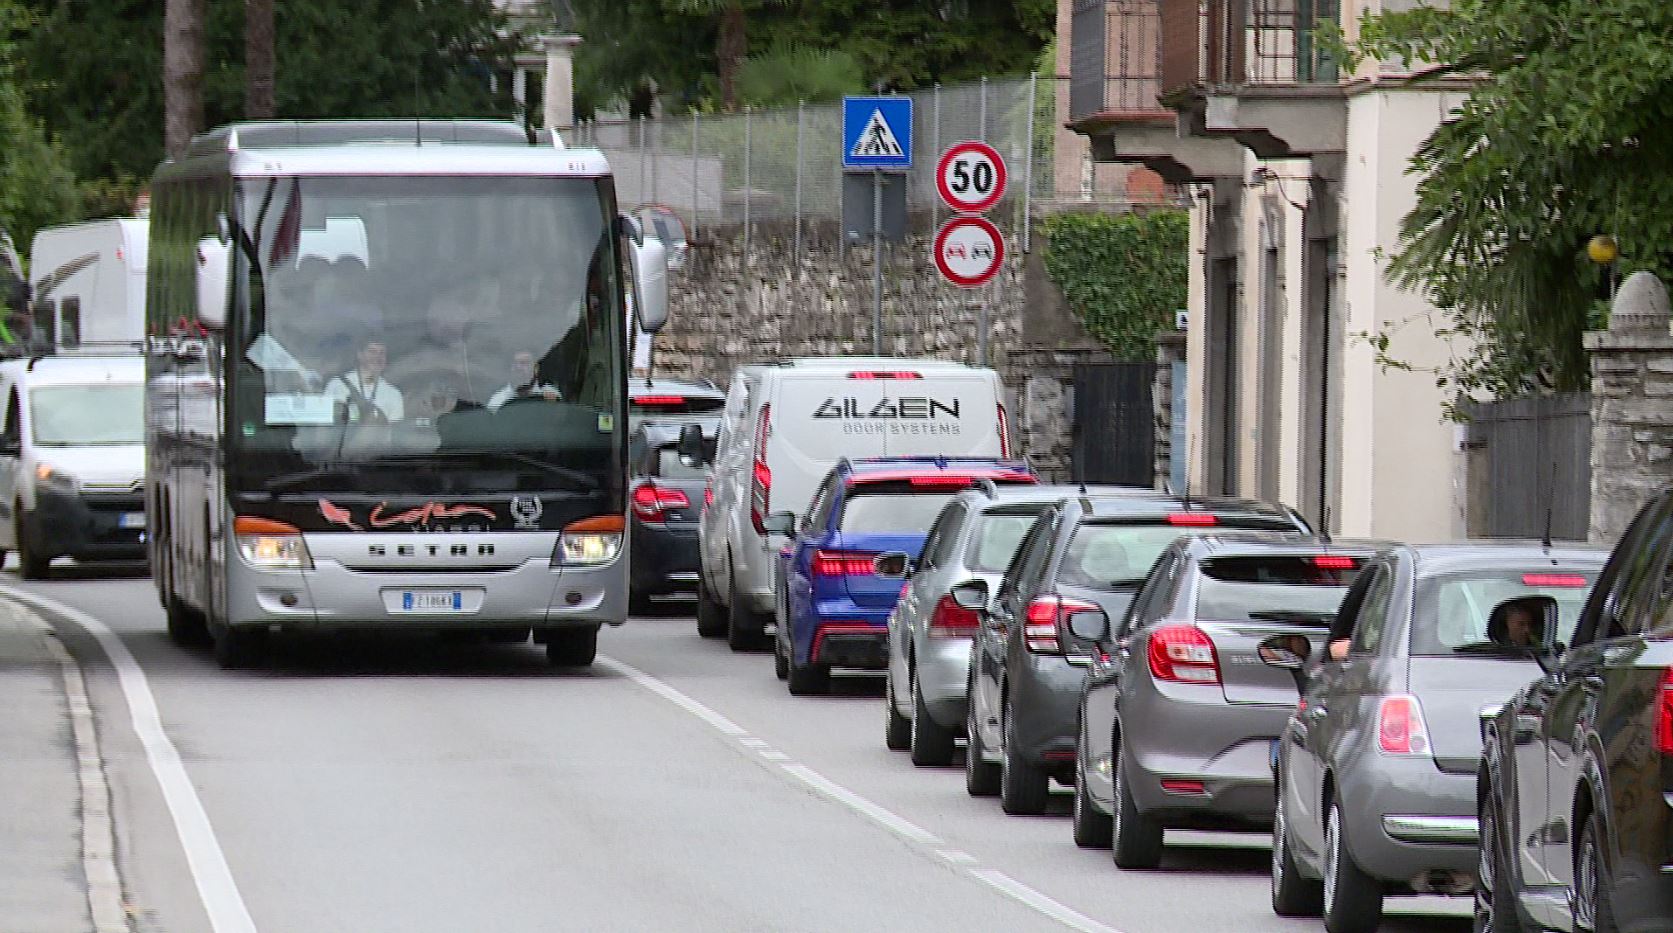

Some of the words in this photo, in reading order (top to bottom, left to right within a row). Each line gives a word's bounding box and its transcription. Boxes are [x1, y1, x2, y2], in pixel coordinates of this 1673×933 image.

[952, 160, 992, 193] 50
[812, 397, 960, 419] GILGEN
[843, 422, 884, 434] DOOR
[890, 422, 960, 434] SYSTEMS
[368, 543, 495, 555] SETRA
